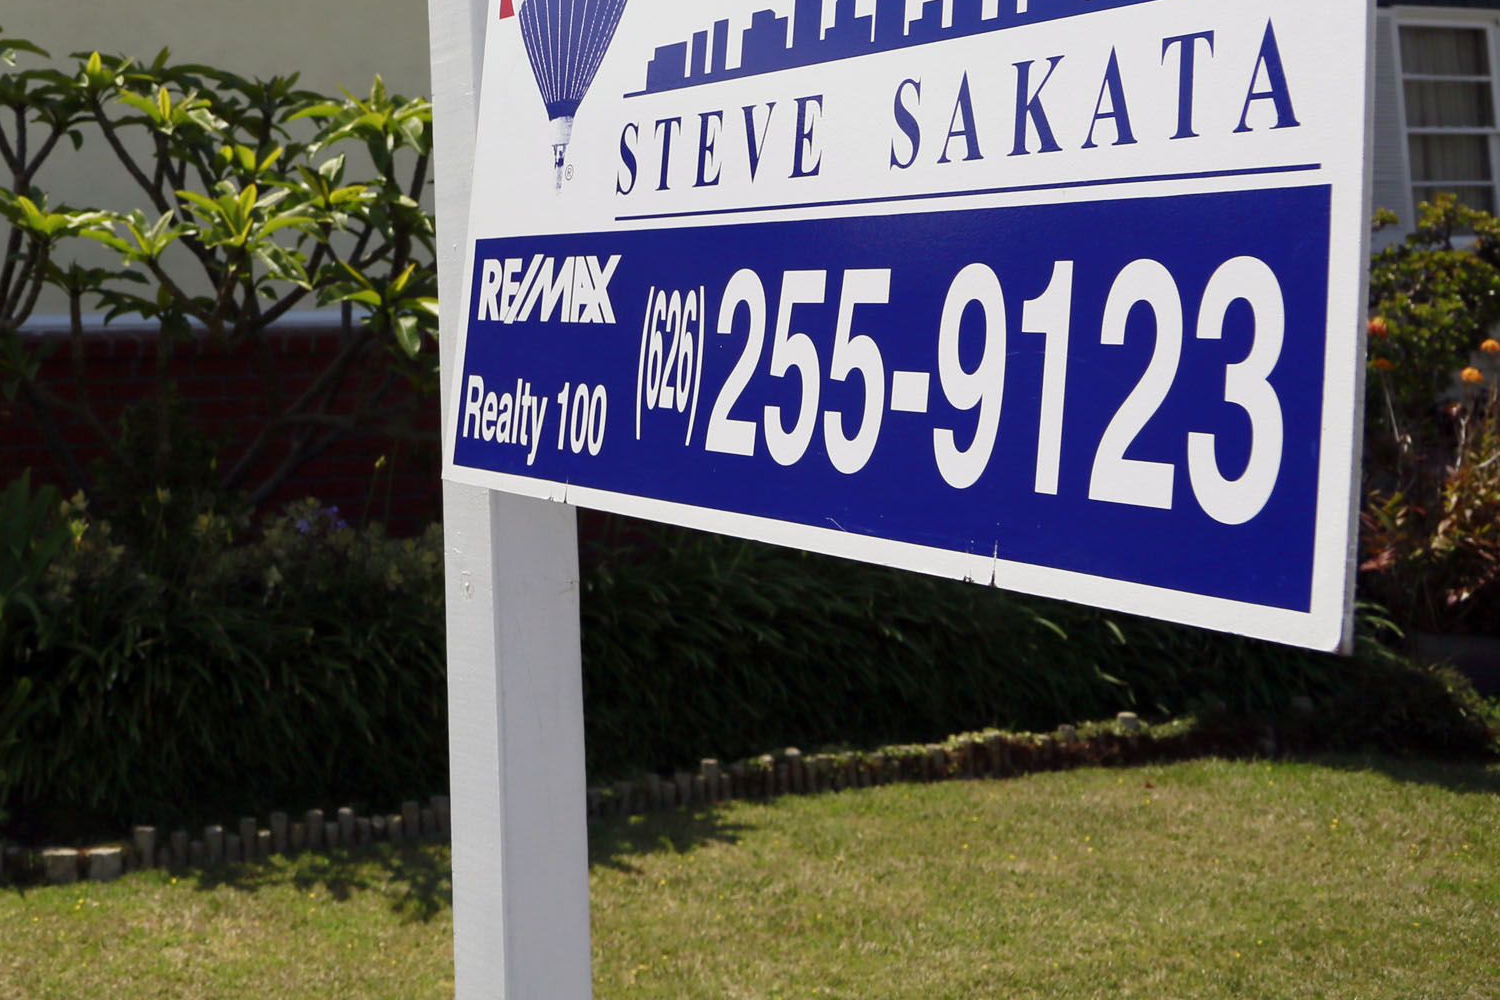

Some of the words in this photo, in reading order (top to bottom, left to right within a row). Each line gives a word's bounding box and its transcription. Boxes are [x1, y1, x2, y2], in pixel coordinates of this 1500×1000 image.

[616, 93, 823, 196] STEVE
[889, 18, 1301, 170] SAKATA
[477, 253, 622, 325] RE/MAX
[462, 374, 549, 466] Realty
[557, 382, 608, 456] 100
[636, 286, 705, 447] (626)
[704, 255, 1285, 526] 255-9123
